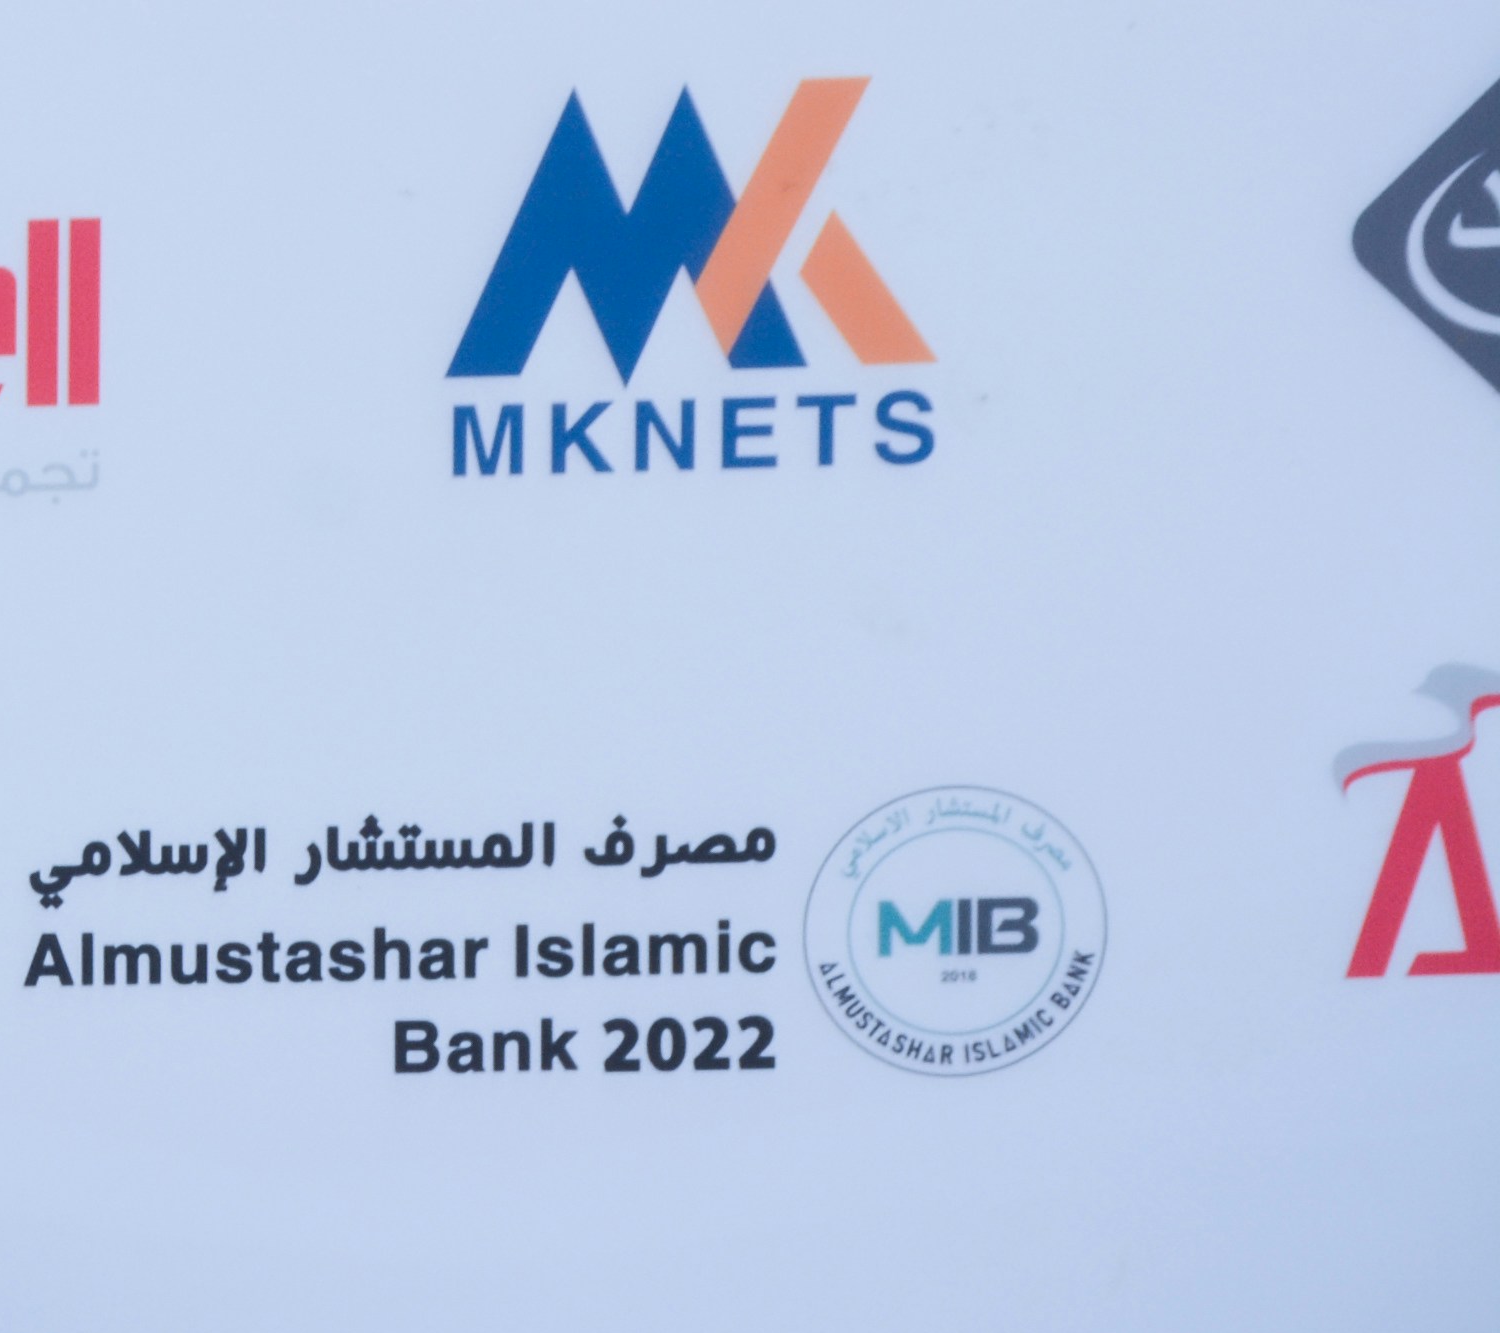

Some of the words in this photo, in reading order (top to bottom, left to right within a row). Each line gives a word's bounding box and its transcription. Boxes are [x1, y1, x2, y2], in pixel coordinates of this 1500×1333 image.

[452, 391, 935, 477] MKNETS
[29, 828, 266, 909] الإسلامي
[294, 814, 555, 885] المستشار
[584, 815, 776, 878] مصرف
[24, 927, 488, 987] Almustashar
[515, 919, 776, 978] Islamic
[877, 897, 1040, 957] MIB
[819, 961, 953, 1065] ALMUSTASHAR
[964, 1008, 1054, 1064] ISLAMIC
[1050, 949, 1095, 1009] BANK
[395, 1018, 577, 1073] Bank
[603, 1015, 775, 1072] 2022
